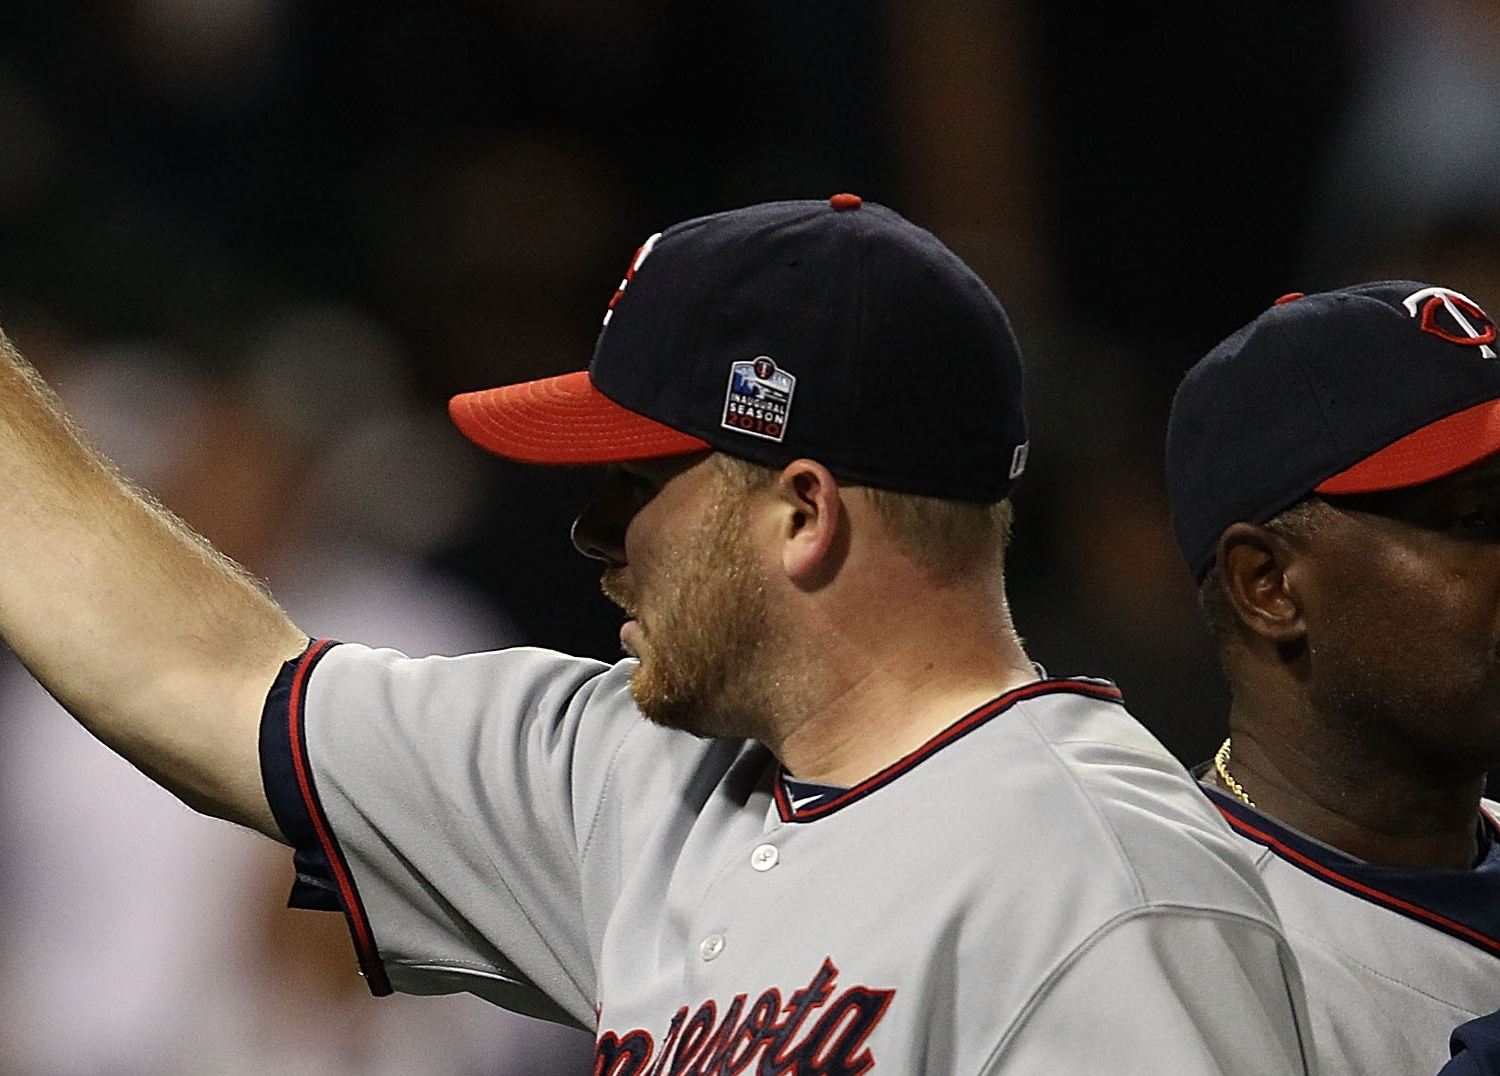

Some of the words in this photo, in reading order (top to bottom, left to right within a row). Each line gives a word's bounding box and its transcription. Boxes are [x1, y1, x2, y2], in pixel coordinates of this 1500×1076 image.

[729, 402, 785, 425] SEASON
[730, 393, 785, 415] INAUGURAL
[727, 412, 781, 436] 2010
